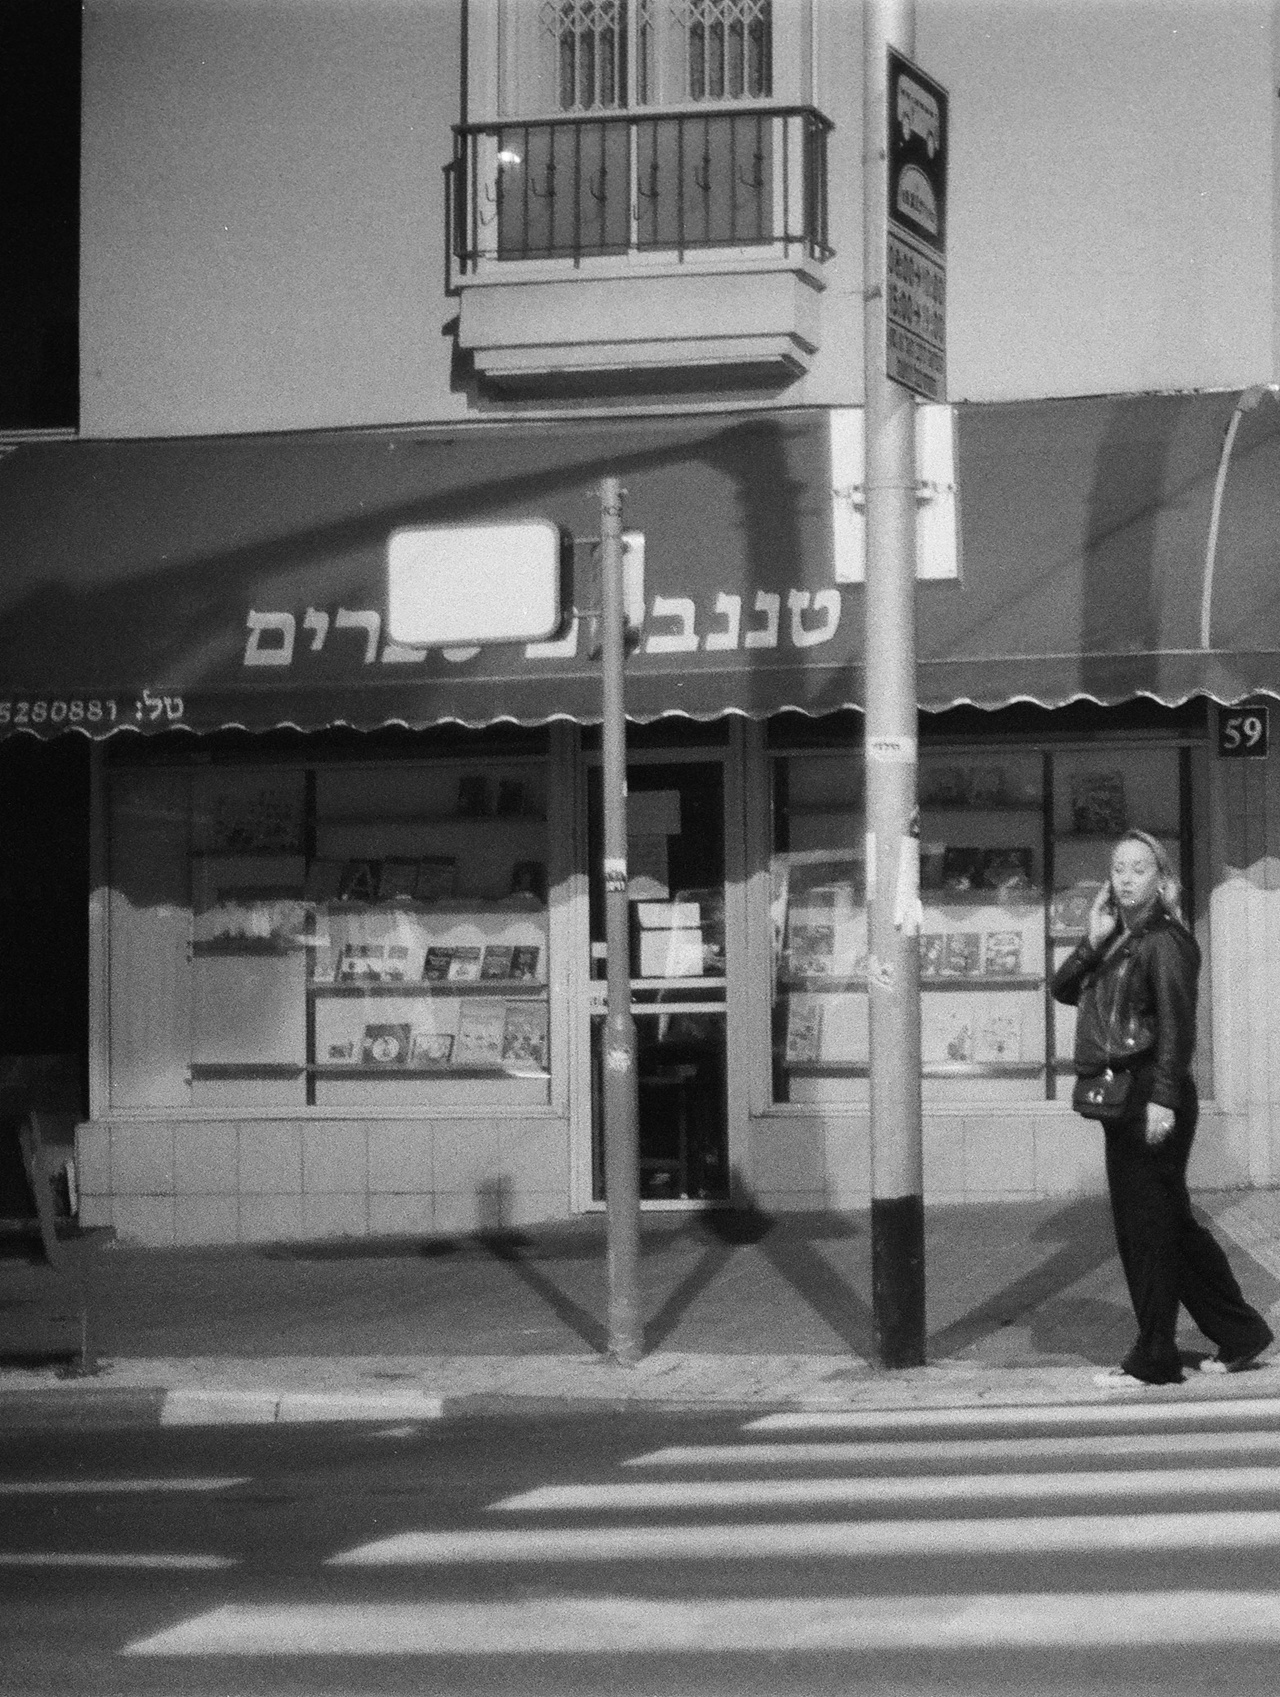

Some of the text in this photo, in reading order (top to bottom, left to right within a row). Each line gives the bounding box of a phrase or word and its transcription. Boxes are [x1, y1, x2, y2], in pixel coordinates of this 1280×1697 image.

[243, 588, 842, 667] טננב רים
[135, 688, 184, 721] טל:
[1223, 716, 1262, 749] 59
